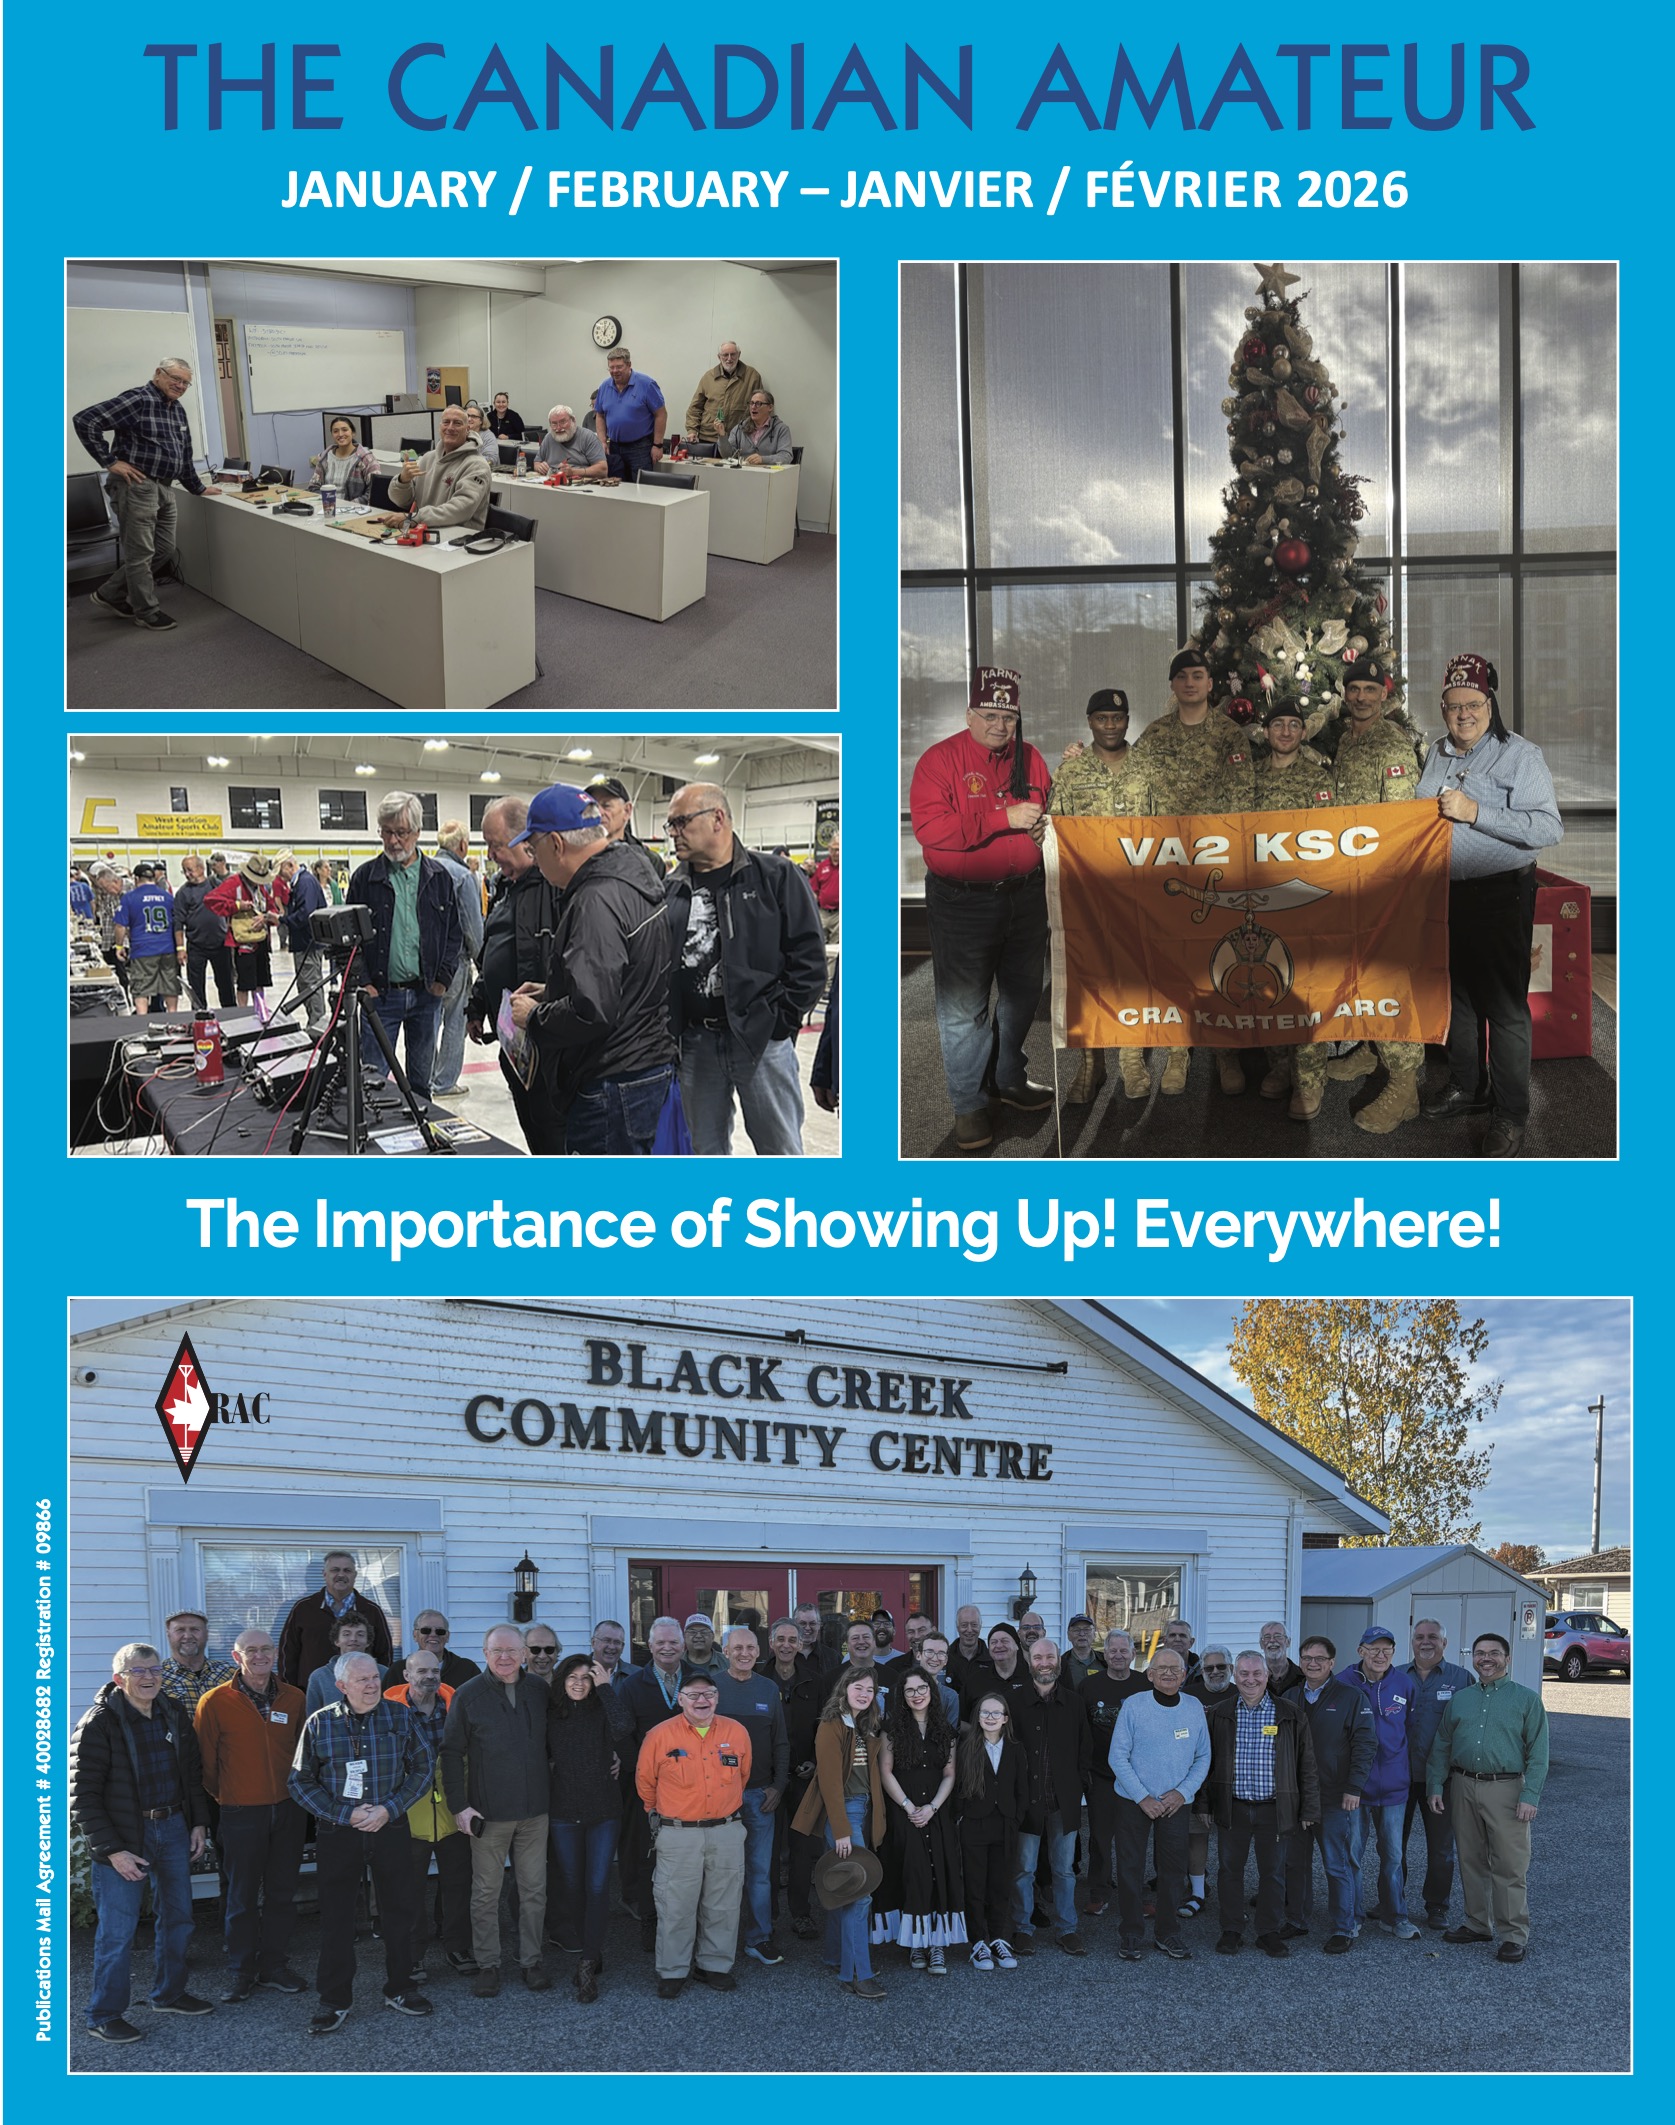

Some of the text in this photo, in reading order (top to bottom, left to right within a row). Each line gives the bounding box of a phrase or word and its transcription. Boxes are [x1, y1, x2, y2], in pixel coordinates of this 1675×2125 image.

[981, 668, 1020, 691] KARNA
[176, 823, 200, 831] Sports
[202, 823, 219, 831] Club
[1118, 826, 1380, 866] VA2 KSC
[143, 905, 169, 933] 19
[1117, 998, 1400, 1030] CRA KARTEM ARC
[585, 1339, 973, 1419] BLACK CREEK
[465, 1395, 1054, 1481] COMMUNITY CENTRE
